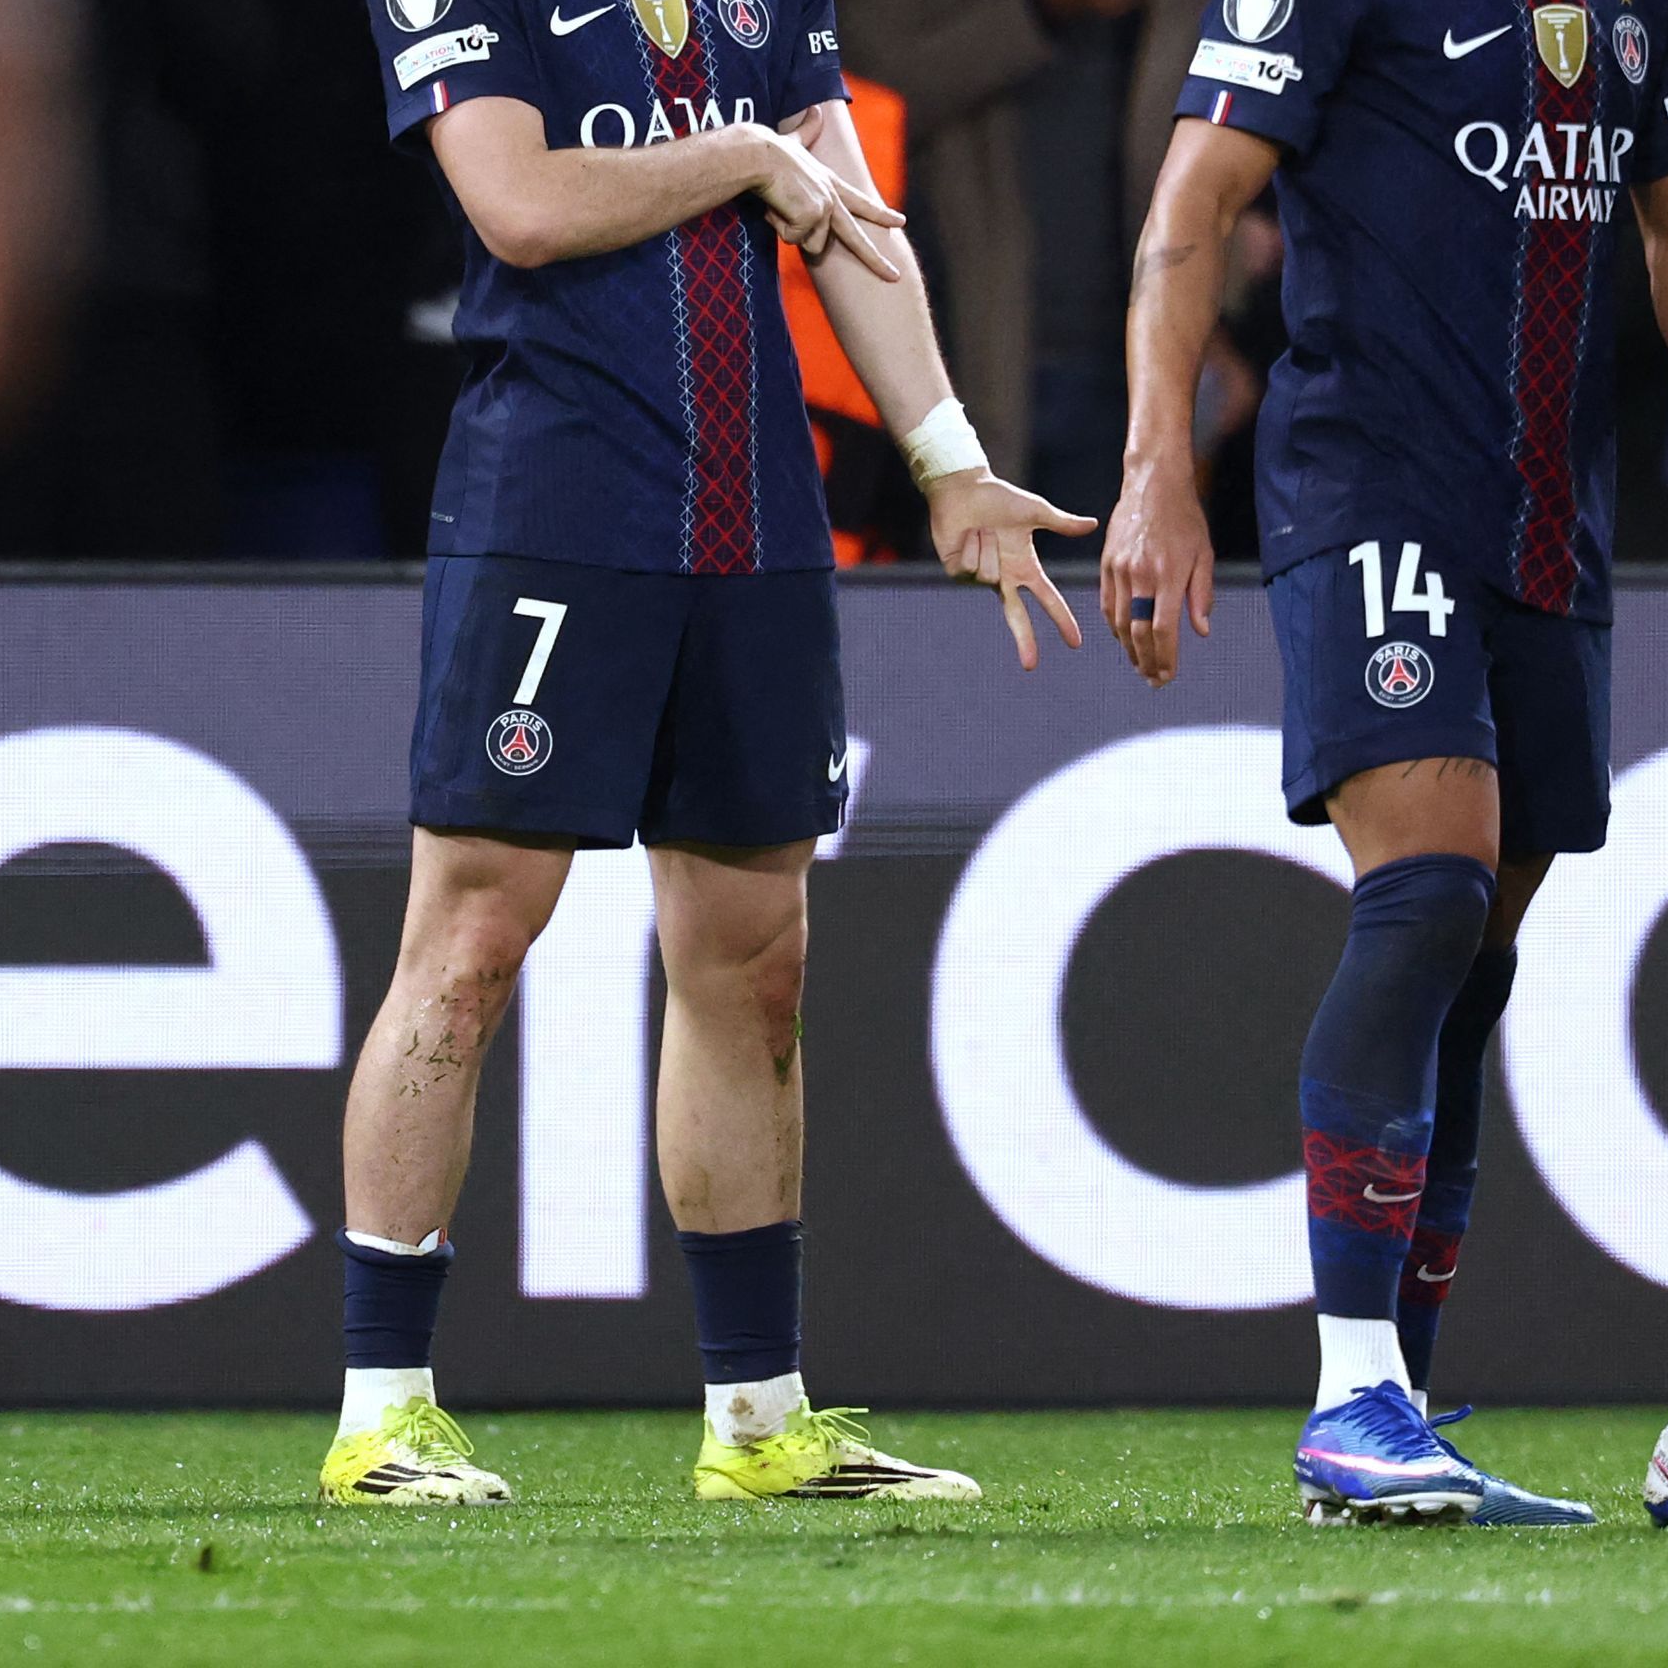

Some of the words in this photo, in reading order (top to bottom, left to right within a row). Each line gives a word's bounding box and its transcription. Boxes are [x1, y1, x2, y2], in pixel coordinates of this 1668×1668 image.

[1454, 120, 1634, 192] QATAR
[1348, 540, 1456, 638] 14
[512, 597, 568, 706] 7
[1374, 646, 1420, 664] PARIS
[499, 713, 543, 732] PARIS
